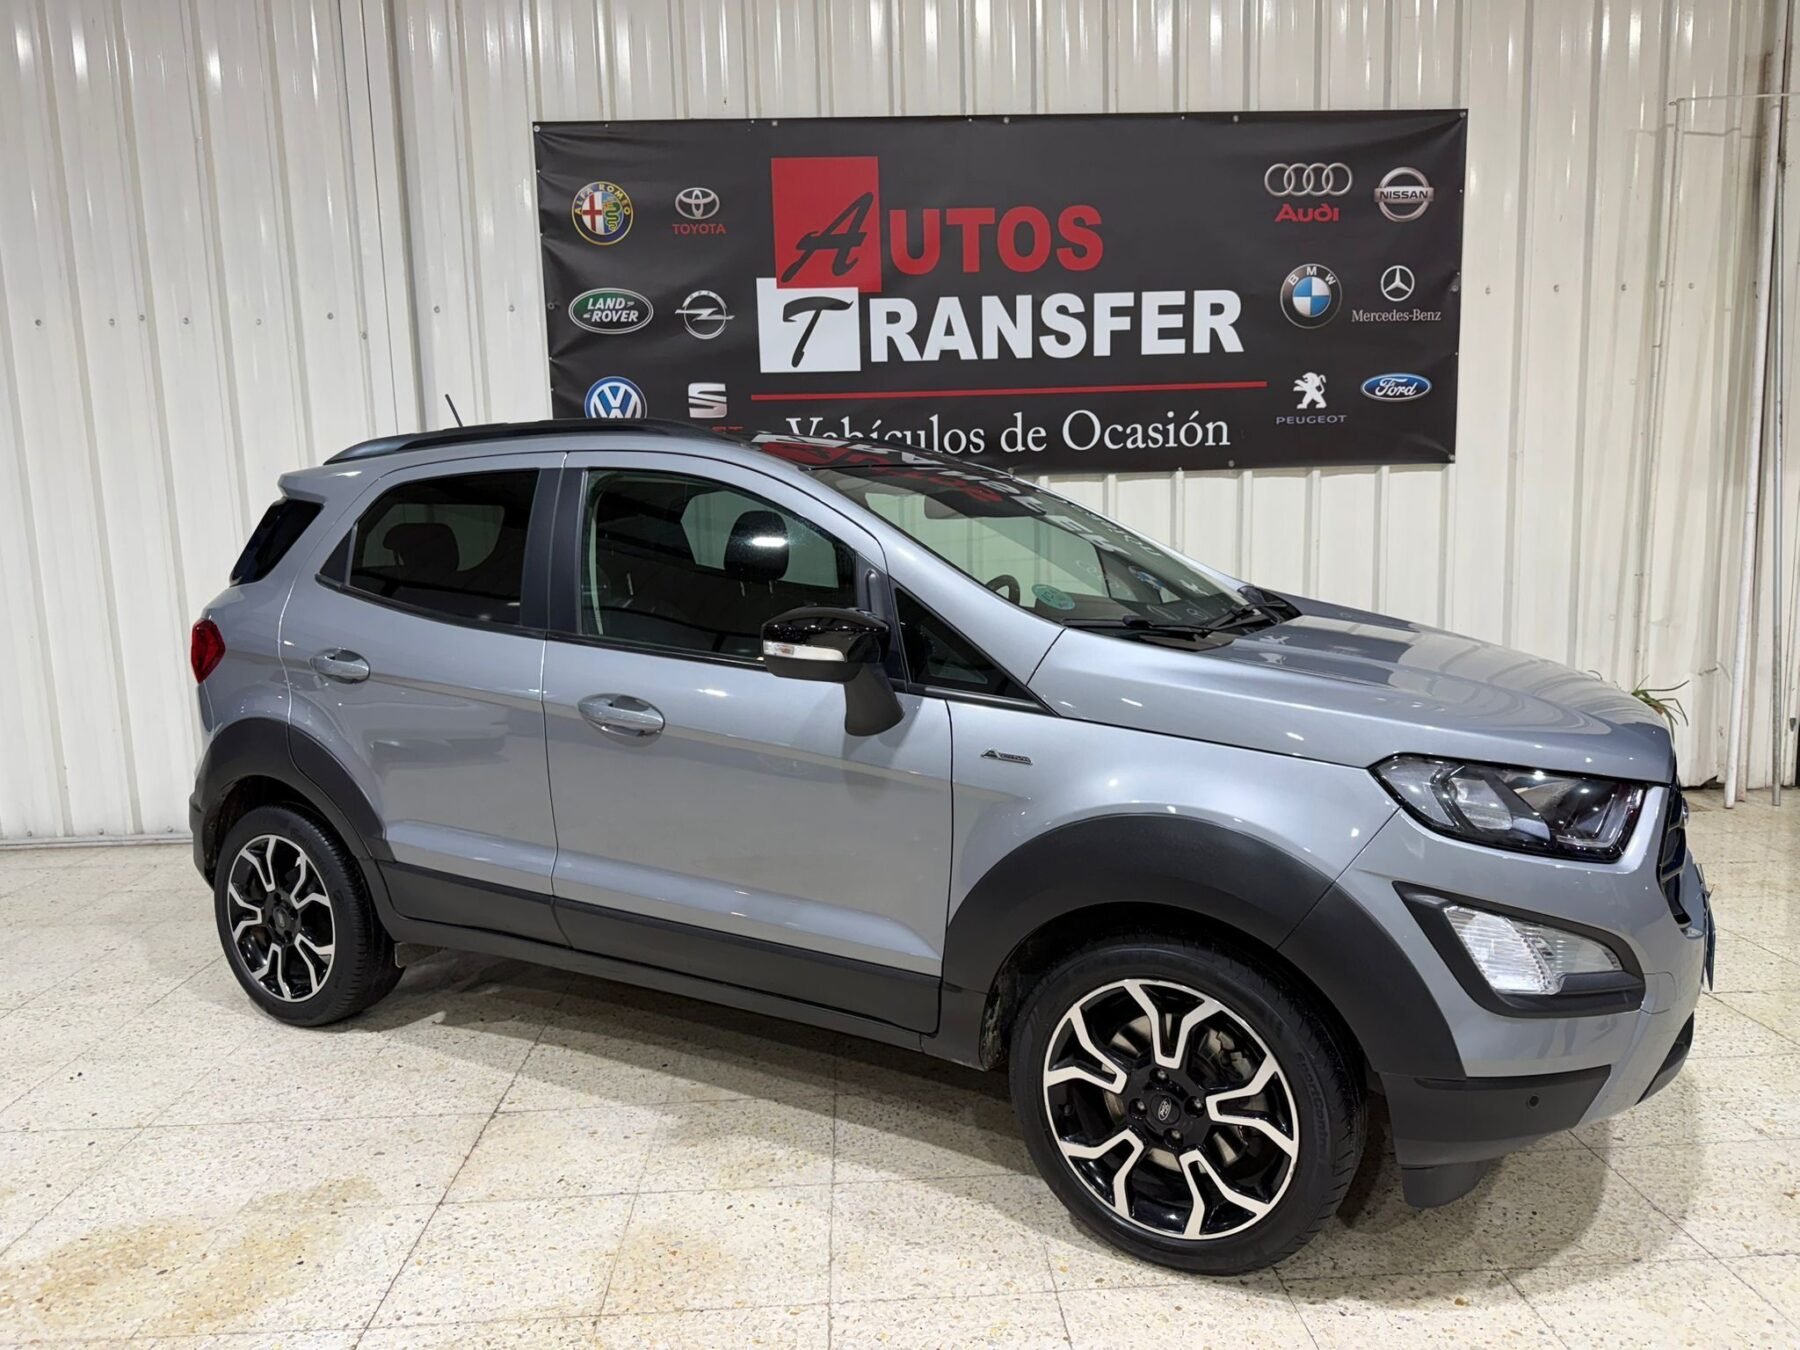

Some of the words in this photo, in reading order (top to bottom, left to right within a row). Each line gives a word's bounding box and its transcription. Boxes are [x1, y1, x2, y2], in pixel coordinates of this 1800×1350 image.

[1380, 190, 1429, 200] NISSAN
[1274, 203, 1340, 223] Audi
[672, 223, 727, 235] TOYOTA
[781, 192, 1104, 283] AUTOS
[1288, 266, 1337, 286] BMW
[587, 297, 626, 310] LAND
[591, 310, 639, 322] ROVER
[1351, 309, 1442, 323] Mercedes-Benz
[782, 289, 1245, 369] TRANSFER
[1375, 377, 1419, 396] Ford
[1276, 414, 1347, 425] PEUGEOT
[1000, 411, 1047, 453] de
[1062, 408, 1231, 451] Ocasión
